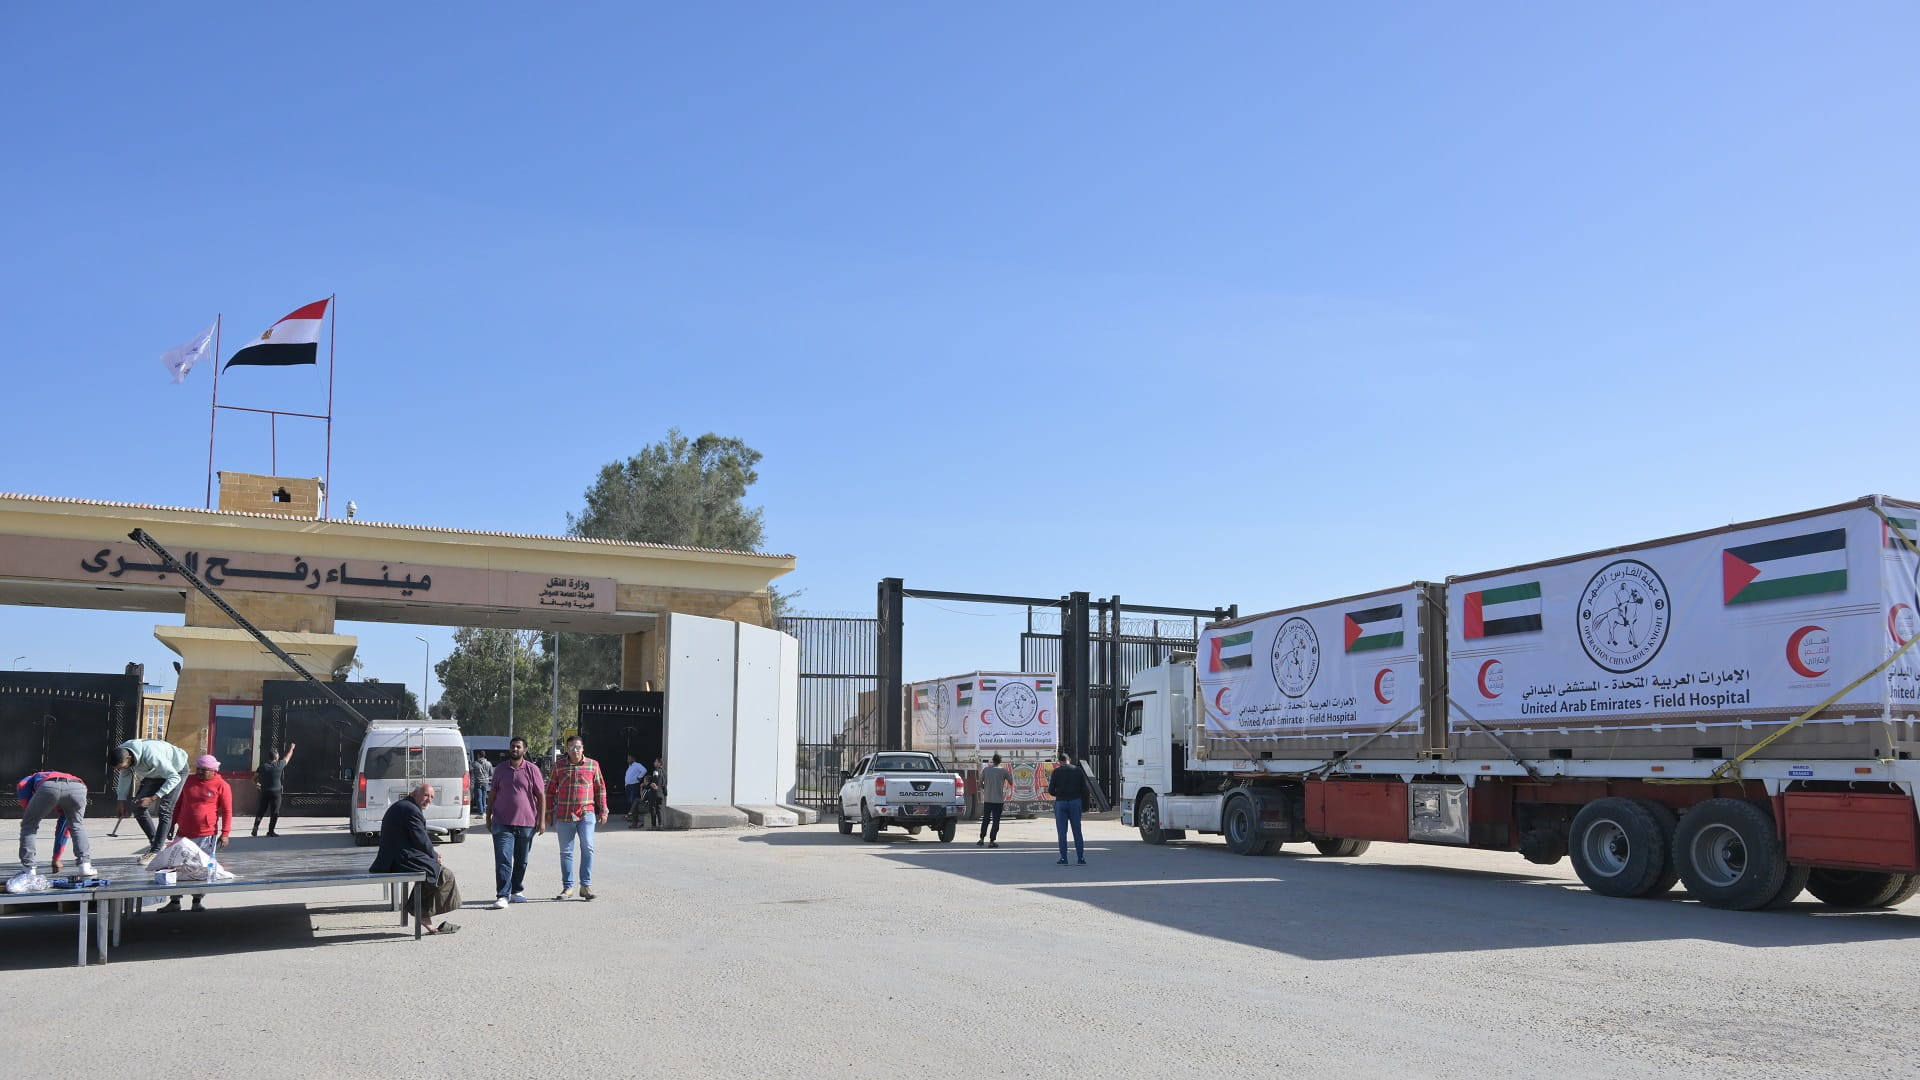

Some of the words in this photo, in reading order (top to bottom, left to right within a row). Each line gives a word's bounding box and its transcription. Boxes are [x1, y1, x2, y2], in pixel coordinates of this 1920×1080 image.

[205, 556, 321, 589] رفح
[326, 562, 432, 596] ميناء
[1610, 566, 1643, 581] الفارس
[547, 577, 566, 588] النقل
[569, 579, 589, 590] وزارة
[1584, 625, 1608, 661] OPERATION
[1609, 647, 1650, 665] CHIVALROUS
[1648, 616, 1663, 647] KNIGHT
[1558, 681, 1600, 696] المستشفى
[1612, 676, 1648, 690] المتحدة
[1652, 673, 1695, 690] العربية
[1522, 684, 1556, 700] الميداني
[1309, 699, 1331, 711] العربية
[1521, 701, 1557, 714] United
[1560, 699, 1587, 713] Arab
[1590, 697, 1641, 711] Emirates
[1653, 692, 1685, 708] Field
[1690, 689, 1750, 708] Hospital
[1239, 718, 1260, 728] United
[1261, 716, 1276, 726] Arab
[1309, 713, 1325, 724] Field
[1327, 711, 1357, 725] Hospital
